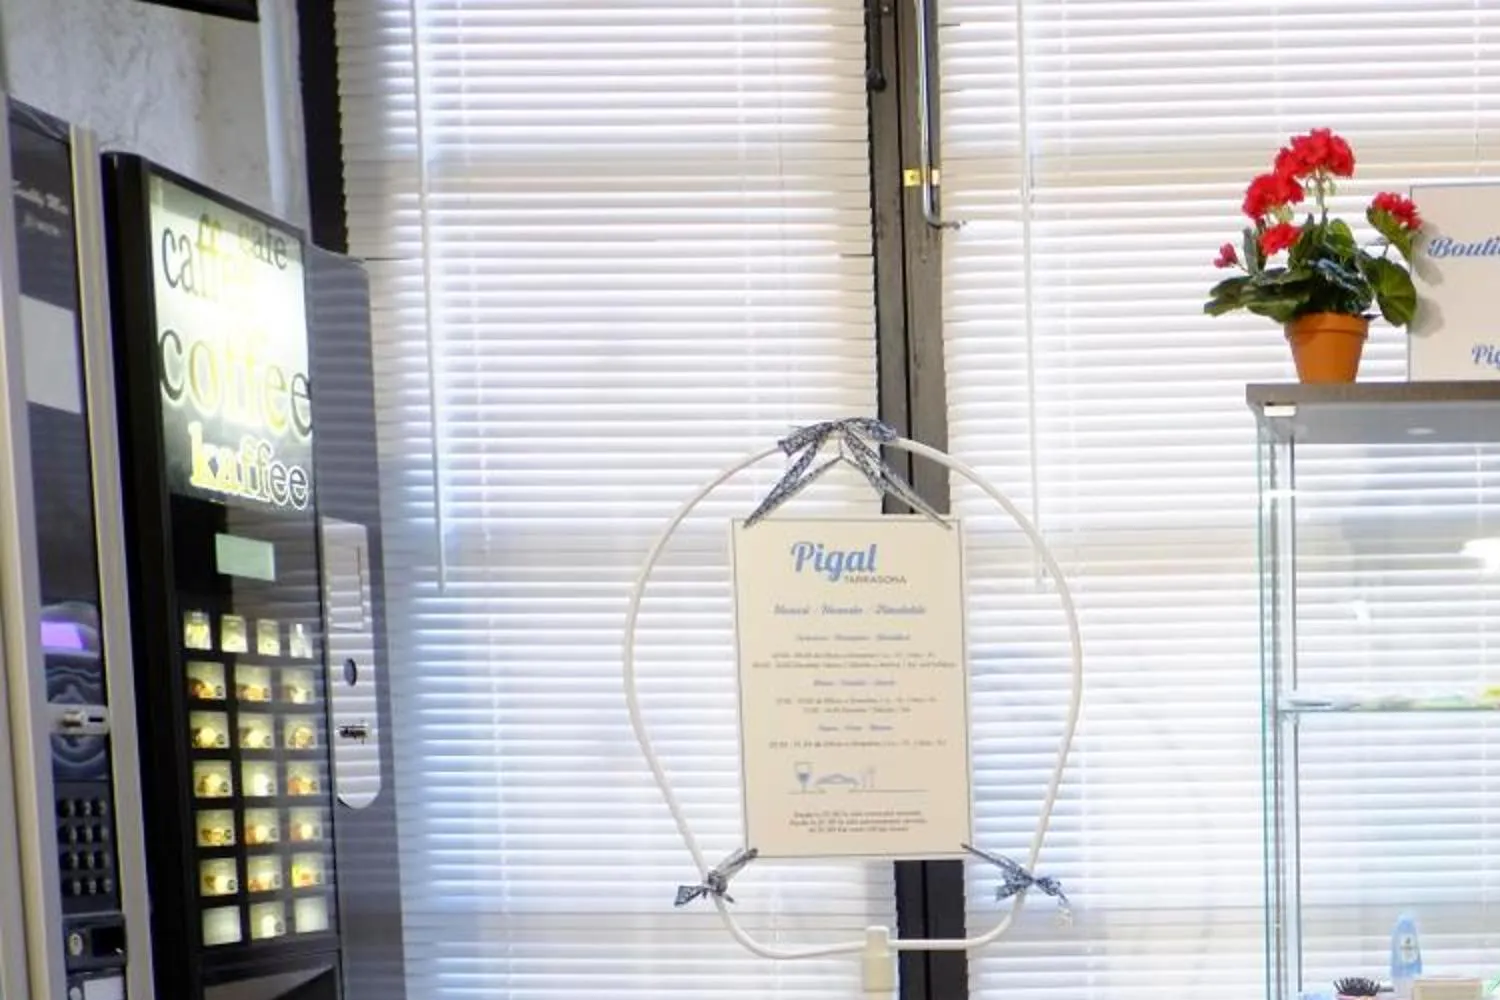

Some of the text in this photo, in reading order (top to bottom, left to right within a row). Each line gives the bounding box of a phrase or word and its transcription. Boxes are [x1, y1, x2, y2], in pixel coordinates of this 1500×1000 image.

[187, 420, 310, 510] kaffee
[790, 541, 878, 583] Pigal
[844, 575, 908, 585] TARRAGONA
